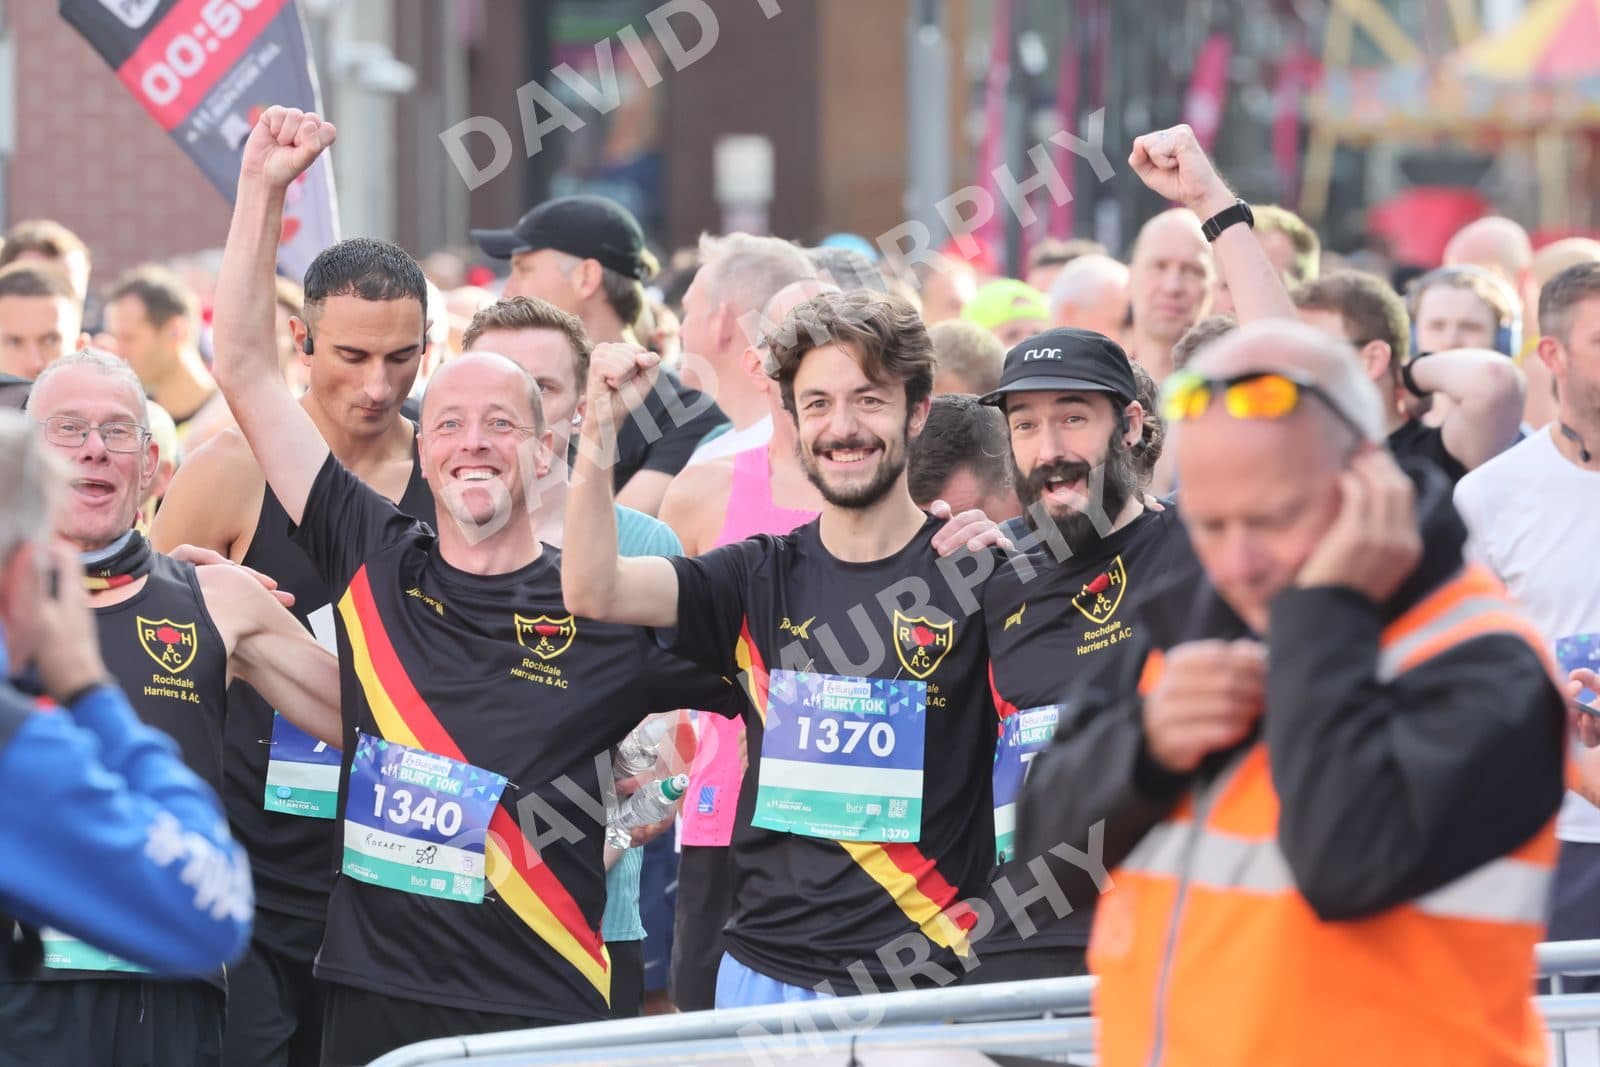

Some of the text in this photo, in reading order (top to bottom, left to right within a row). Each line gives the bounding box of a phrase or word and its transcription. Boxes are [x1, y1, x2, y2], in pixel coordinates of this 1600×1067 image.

[1084, 620, 1121, 641] Rochdale
[1076, 627, 1133, 656] Harriers & AC
[522, 657, 562, 677] Rochdale
[152, 674, 194, 689] Rochdale
[510, 667, 545, 684] Harriers
[554, 678, 569, 690] AC
[144, 686, 179, 700] Harriers
[932, 697, 947, 708] AC
[823, 696, 885, 713] BURY 10K
[797, 716, 896, 758] 1370
[1021, 727, 1047, 744] BURY
[399, 767, 462, 794] BURY 10K
[373, 783, 463, 838] 1340
[881, 827, 910, 839] 1370
